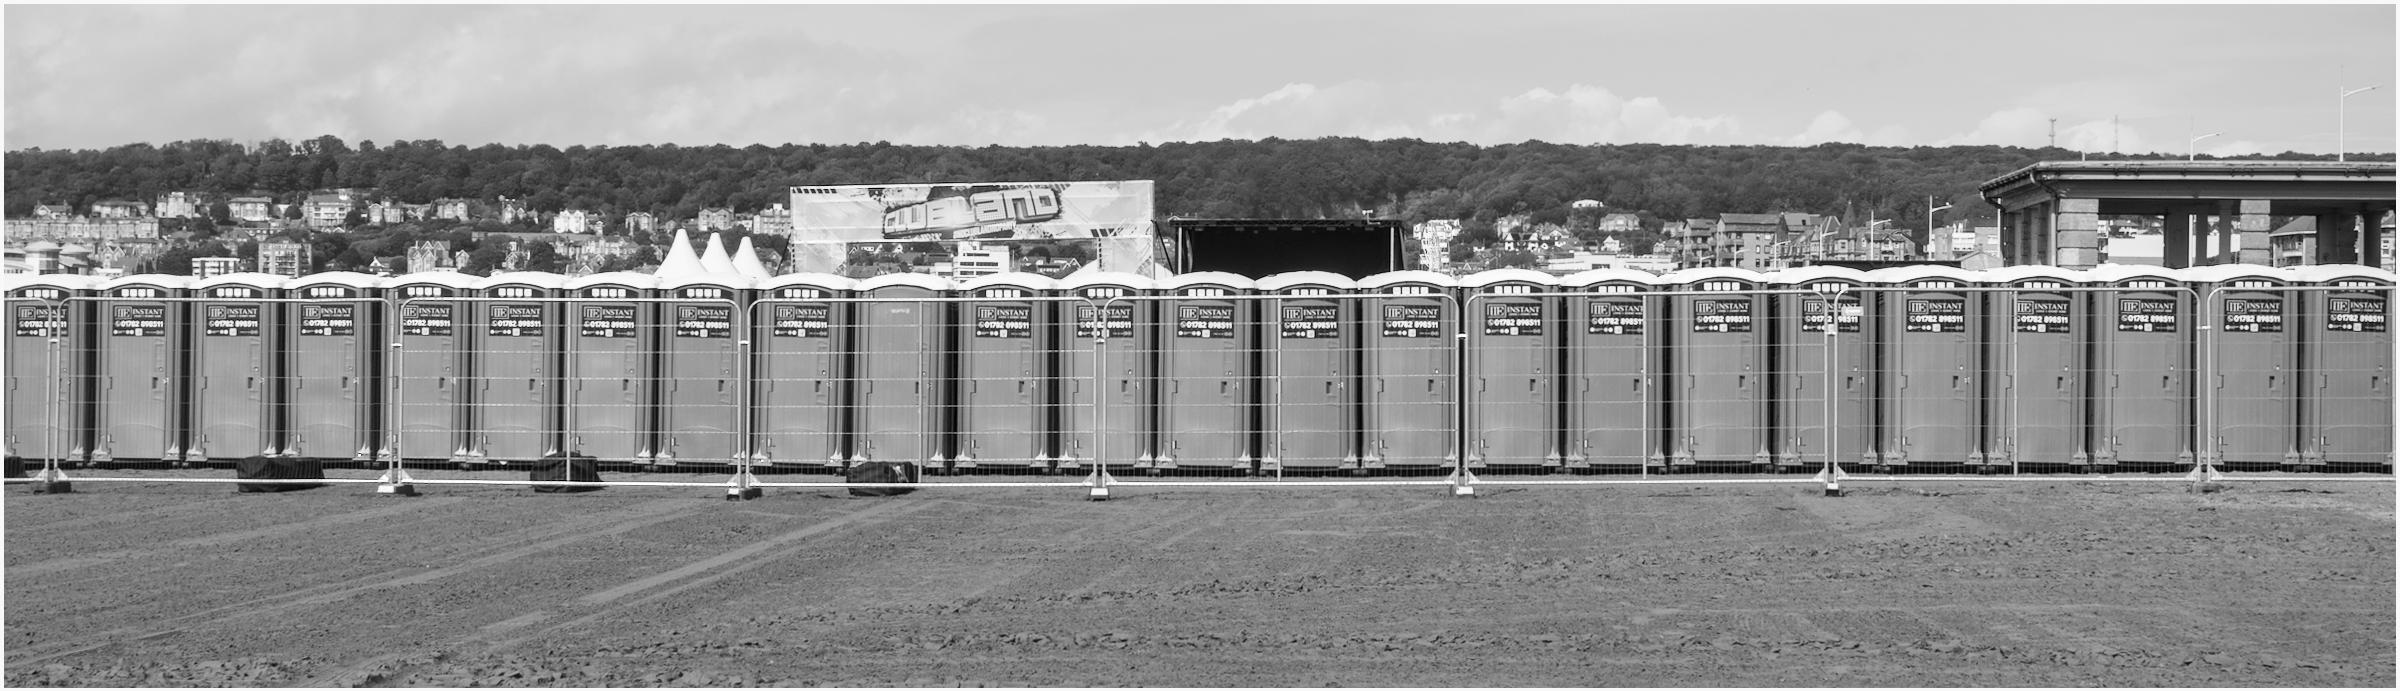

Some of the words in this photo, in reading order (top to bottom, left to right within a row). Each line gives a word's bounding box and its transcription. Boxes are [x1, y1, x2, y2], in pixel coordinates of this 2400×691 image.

[1716, 302, 1749, 310] INSTANT
[1303, 308, 1336, 316] INSTANT
[1494, 318, 1515, 326] 01782
[1598, 317, 1619, 325] 01782
[1703, 315, 1724, 323] 01782
[1811, 315, 1833, 323] 0172
[1916, 315, 1937, 323] 01782
[2021, 315, 2043, 323] 01782
[2128, 314, 2149, 322] 01782
[2233, 314, 2255, 322] 01782
[2337, 314, 2358, 322] 01782
[309, 319, 329, 327] 01782
[782, 320, 803, 328] 01782
[1290, 321, 1312, 329] 01782
[1392, 320, 1413, 328] 01782
